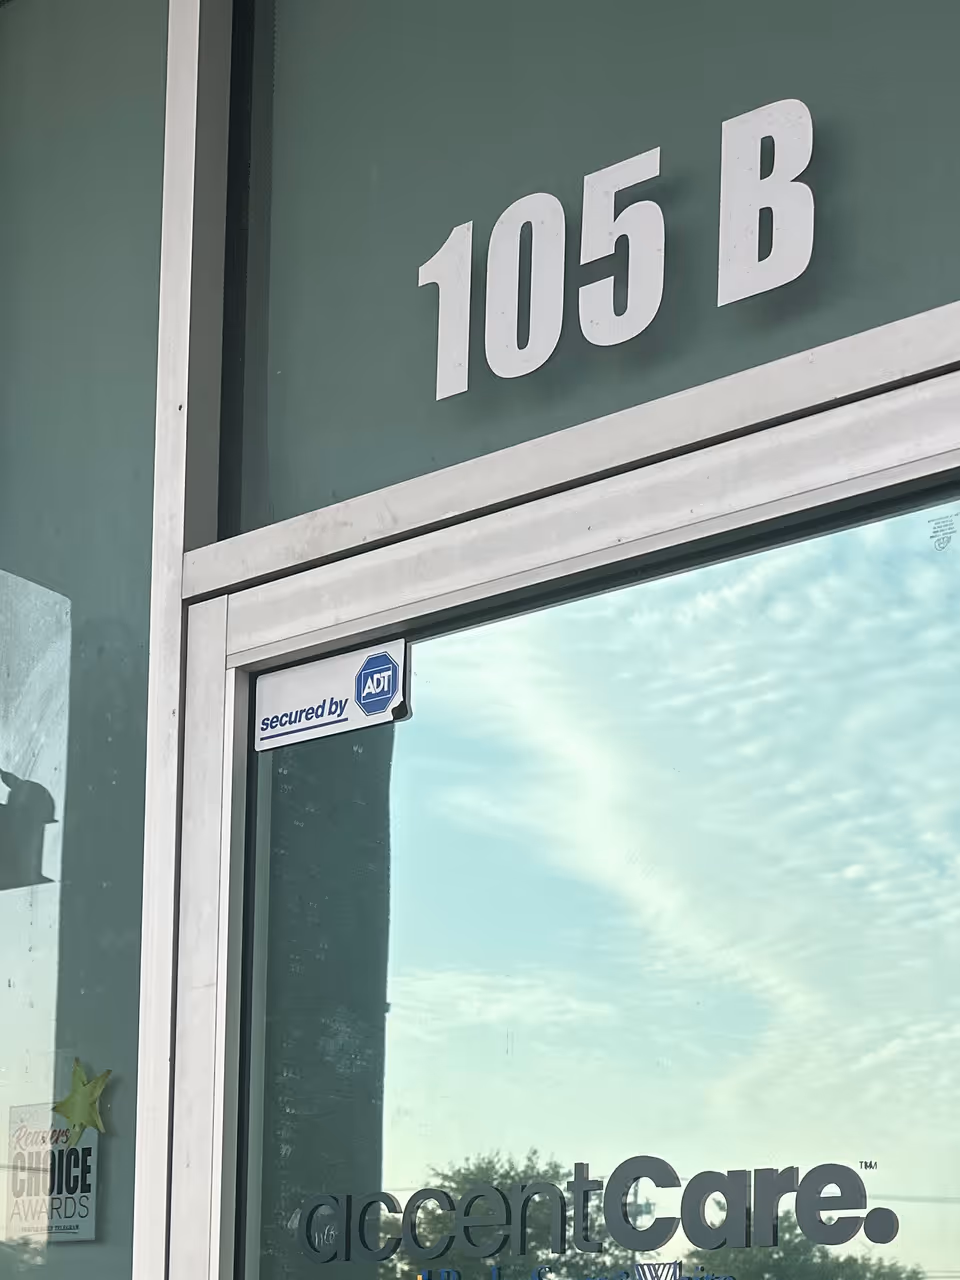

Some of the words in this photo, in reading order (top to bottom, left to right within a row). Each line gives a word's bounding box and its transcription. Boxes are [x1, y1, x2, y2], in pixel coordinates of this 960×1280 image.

[417, 146, 666, 401] 105
[717, 98, 815, 308] B
[362, 671, 392, 698] ADT
[260, 699, 326, 732] secured
[328, 697, 349, 718] by
[11, 1147, 92, 1198] CHOICE
[10, 1195, 89, 1222] AWARDS
